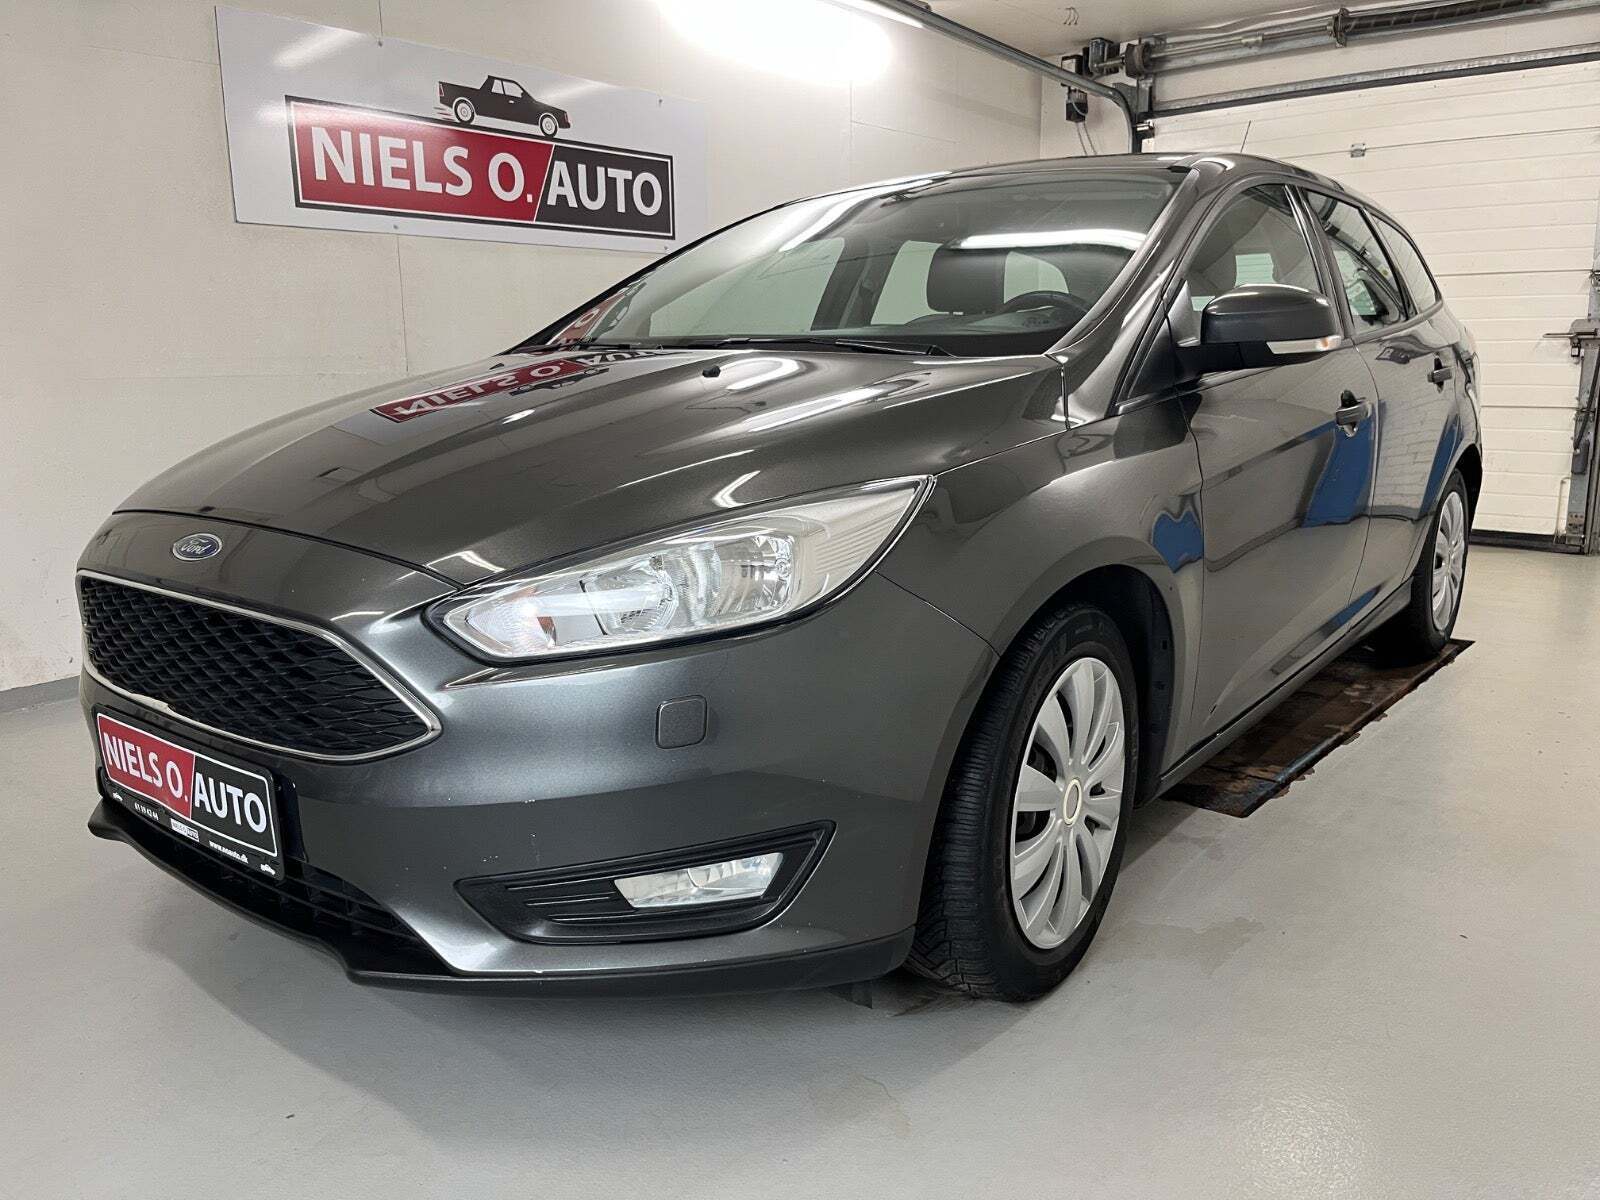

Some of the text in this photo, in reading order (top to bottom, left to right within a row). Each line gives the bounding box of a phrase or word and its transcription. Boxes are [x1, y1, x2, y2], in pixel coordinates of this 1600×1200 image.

[311, 126, 662, 216] NIELS O. AUTO
[103, 732, 163, 788] NIELS
[165, 760, 189, 803] O.
[194, 771, 267, 833] AUTO
